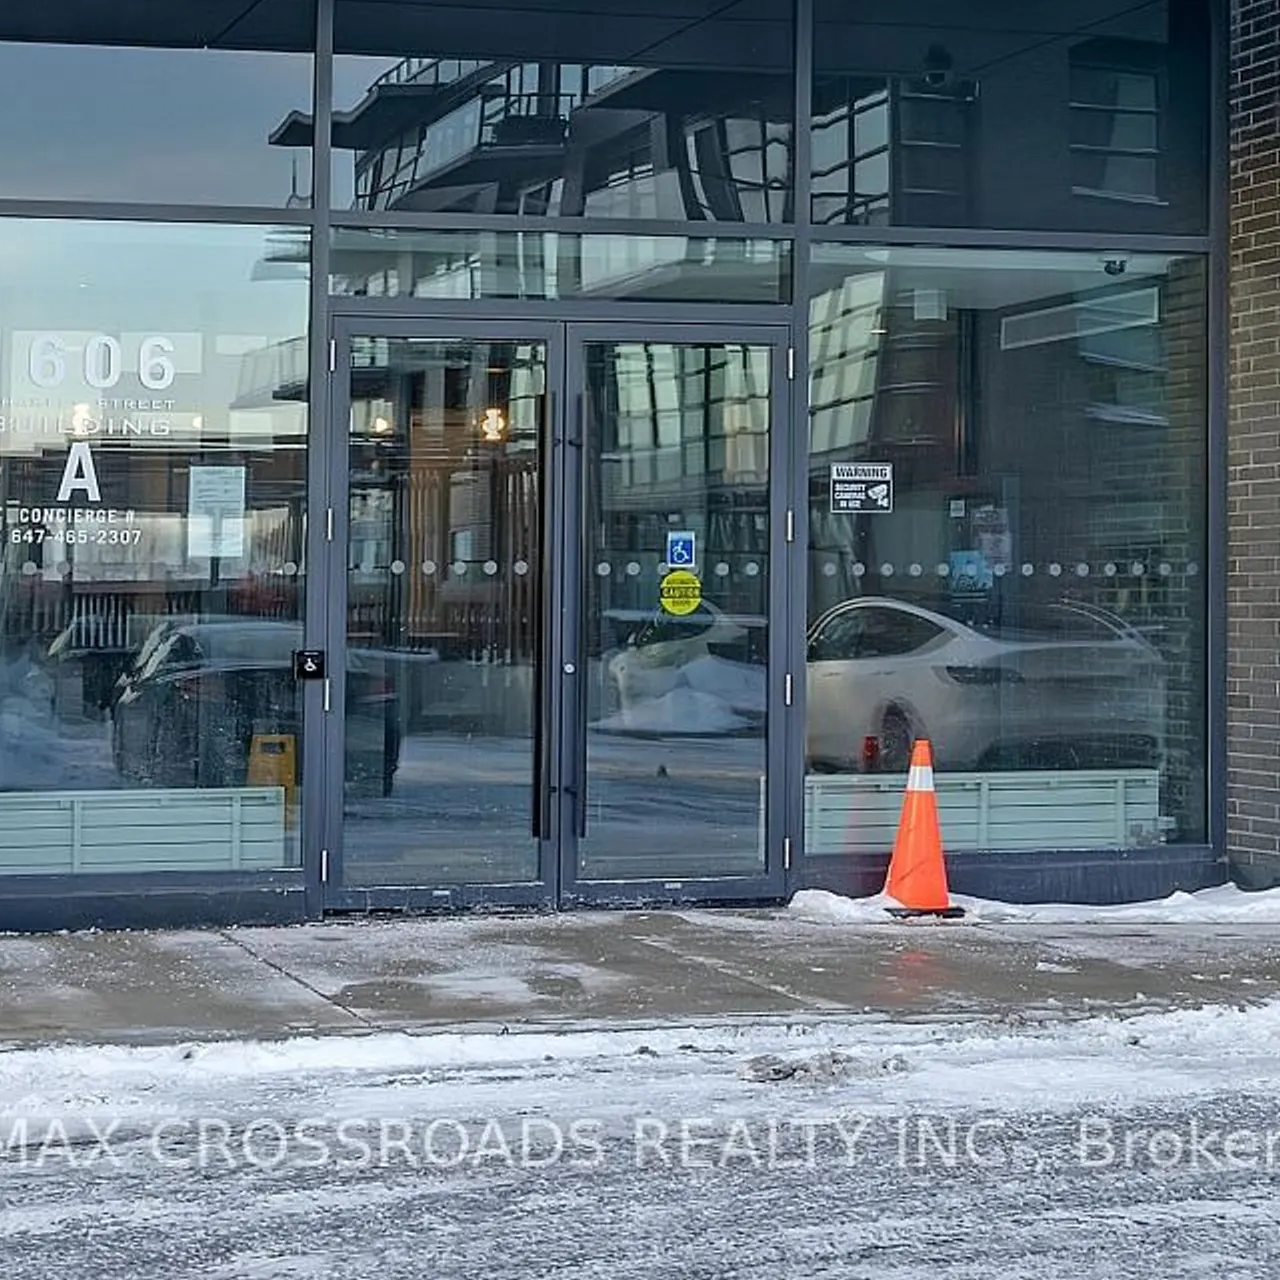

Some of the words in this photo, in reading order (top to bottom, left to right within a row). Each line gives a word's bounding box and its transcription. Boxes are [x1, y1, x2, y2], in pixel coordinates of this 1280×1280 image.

[96, 399, 176, 410] STREET
[56, 442, 101, 501] A
[836, 467, 889, 478] WARNING
[19, 508, 118, 523] CONCIERGE
[11, 530, 142, 545] 647-465-2307
